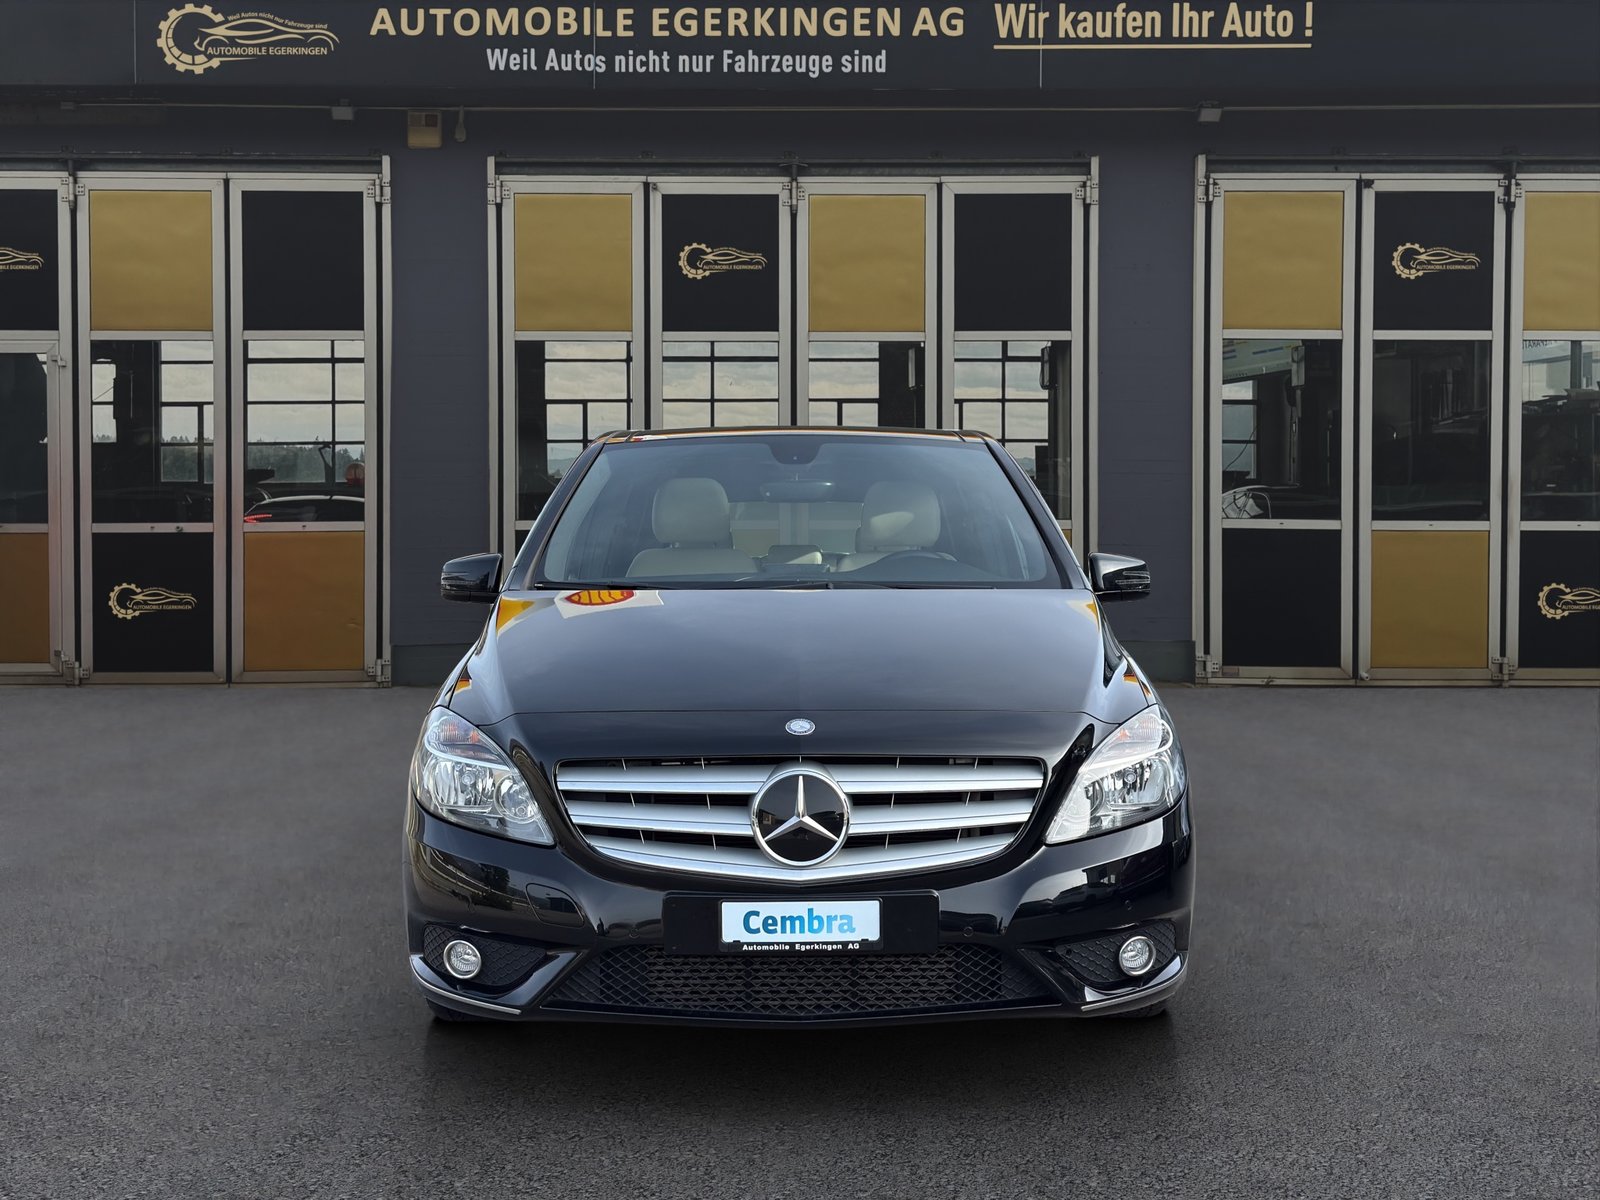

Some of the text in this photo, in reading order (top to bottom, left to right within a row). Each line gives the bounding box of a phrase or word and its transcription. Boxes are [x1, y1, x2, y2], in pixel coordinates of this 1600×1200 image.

[369, 7, 965, 37] AUTOMOBILE EGERKINGEN AG
[994, 2, 1050, 39] Wir
[1058, 2, 1162, 38] kaufen
[1172, 2, 1215, 38] Ihr
[1221, 2, 1294, 38] Auto
[206, 46, 328, 56] AUTOMOBILE EGERKINGEN
[486, 48, 887, 79] Weil Autos nicht nur Fahrzeuge sind
[743, 908, 857, 935] Cembra
[742, 942, 860, 951] Automobile Egerkingen AG
